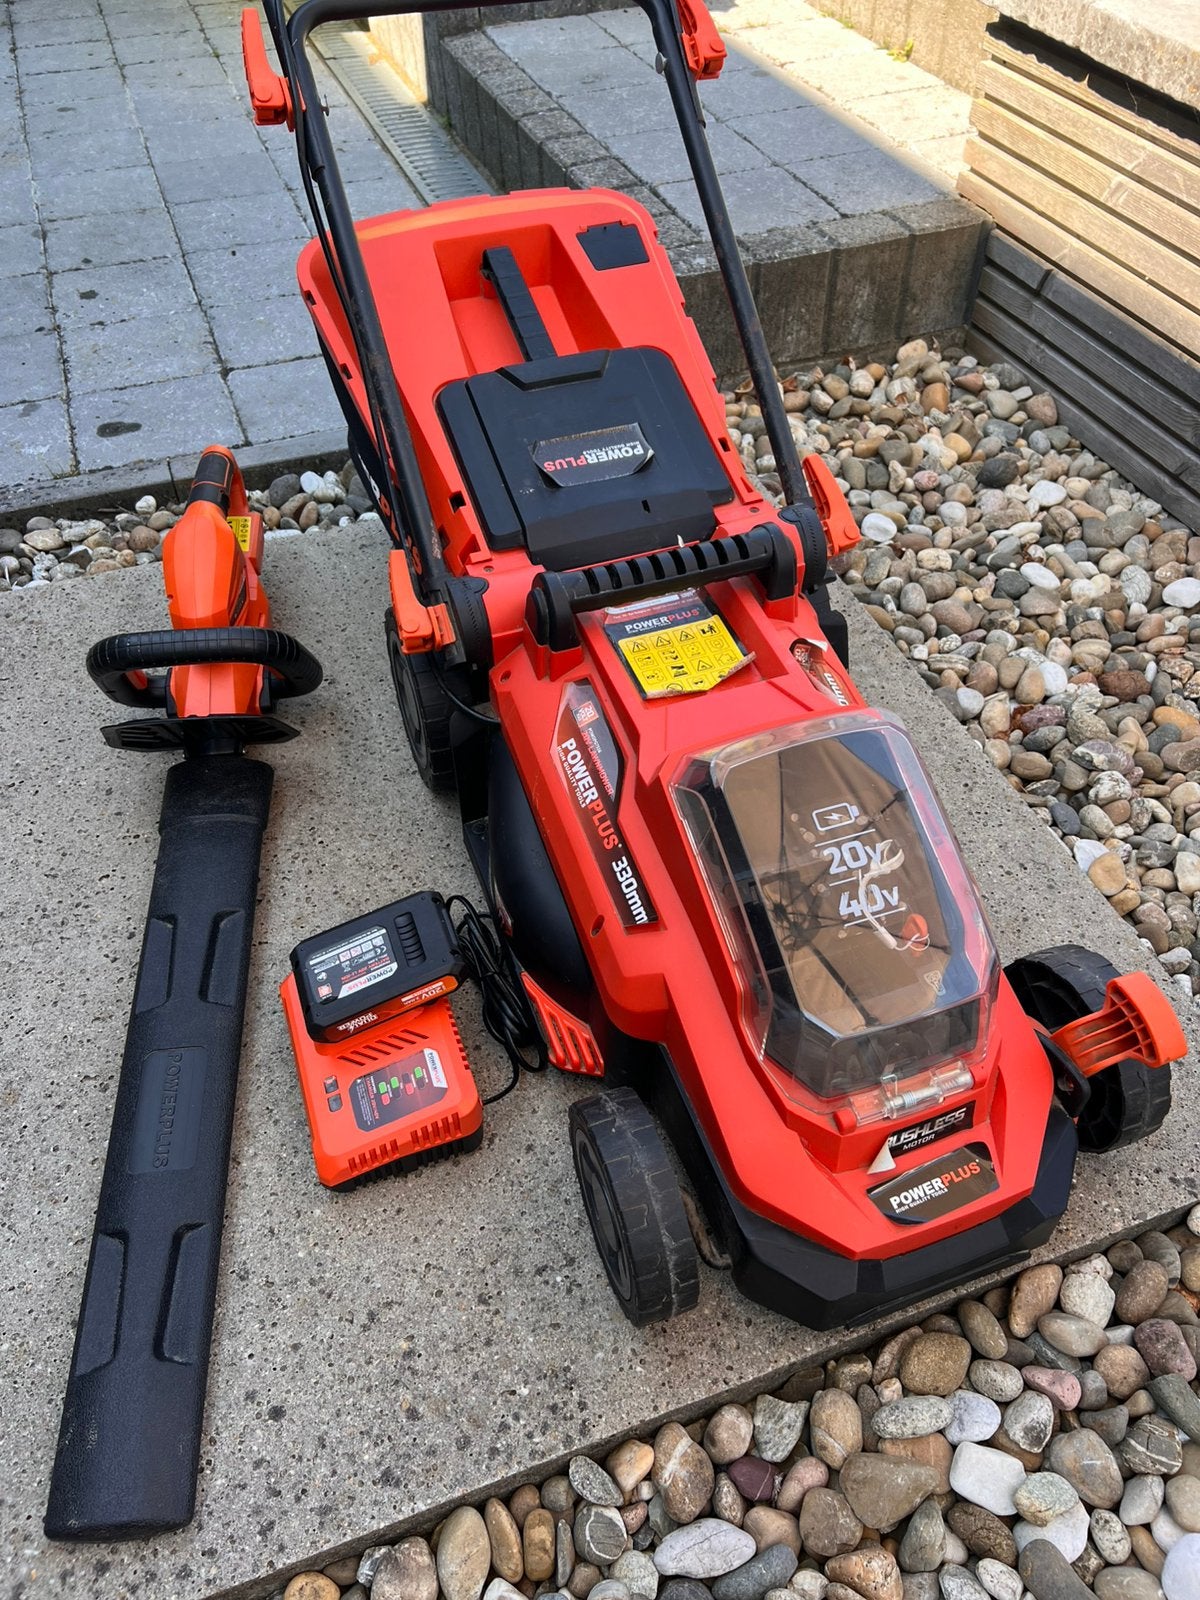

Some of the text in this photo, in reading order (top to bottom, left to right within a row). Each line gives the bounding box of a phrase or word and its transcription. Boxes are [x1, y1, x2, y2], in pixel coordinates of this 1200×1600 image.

[543, 443, 644, 472] POWERPLUS
[624, 608, 700, 632] POWERPLUS
[557, 746, 587, 808] HIGH QUALITY TOOLS
[588, 746, 615, 795] LAWNMOWER
[562, 737, 648, 924] POWERPLUS 330mm
[347, 967, 393, 991] POWERPLUS
[422, 986, 443, 1000] 20V
[428, 1052, 441, 1083] POWERPLUS
[152, 1052, 183, 1169] POWERPLUS
[886, 1107, 967, 1148] RUSHLESS
[902, 1133, 936, 1150] MOTOR
[889, 1161, 982, 1209] POWERPLUS
[895, 1187, 948, 1214] HIGH QUALITY TOOLS
